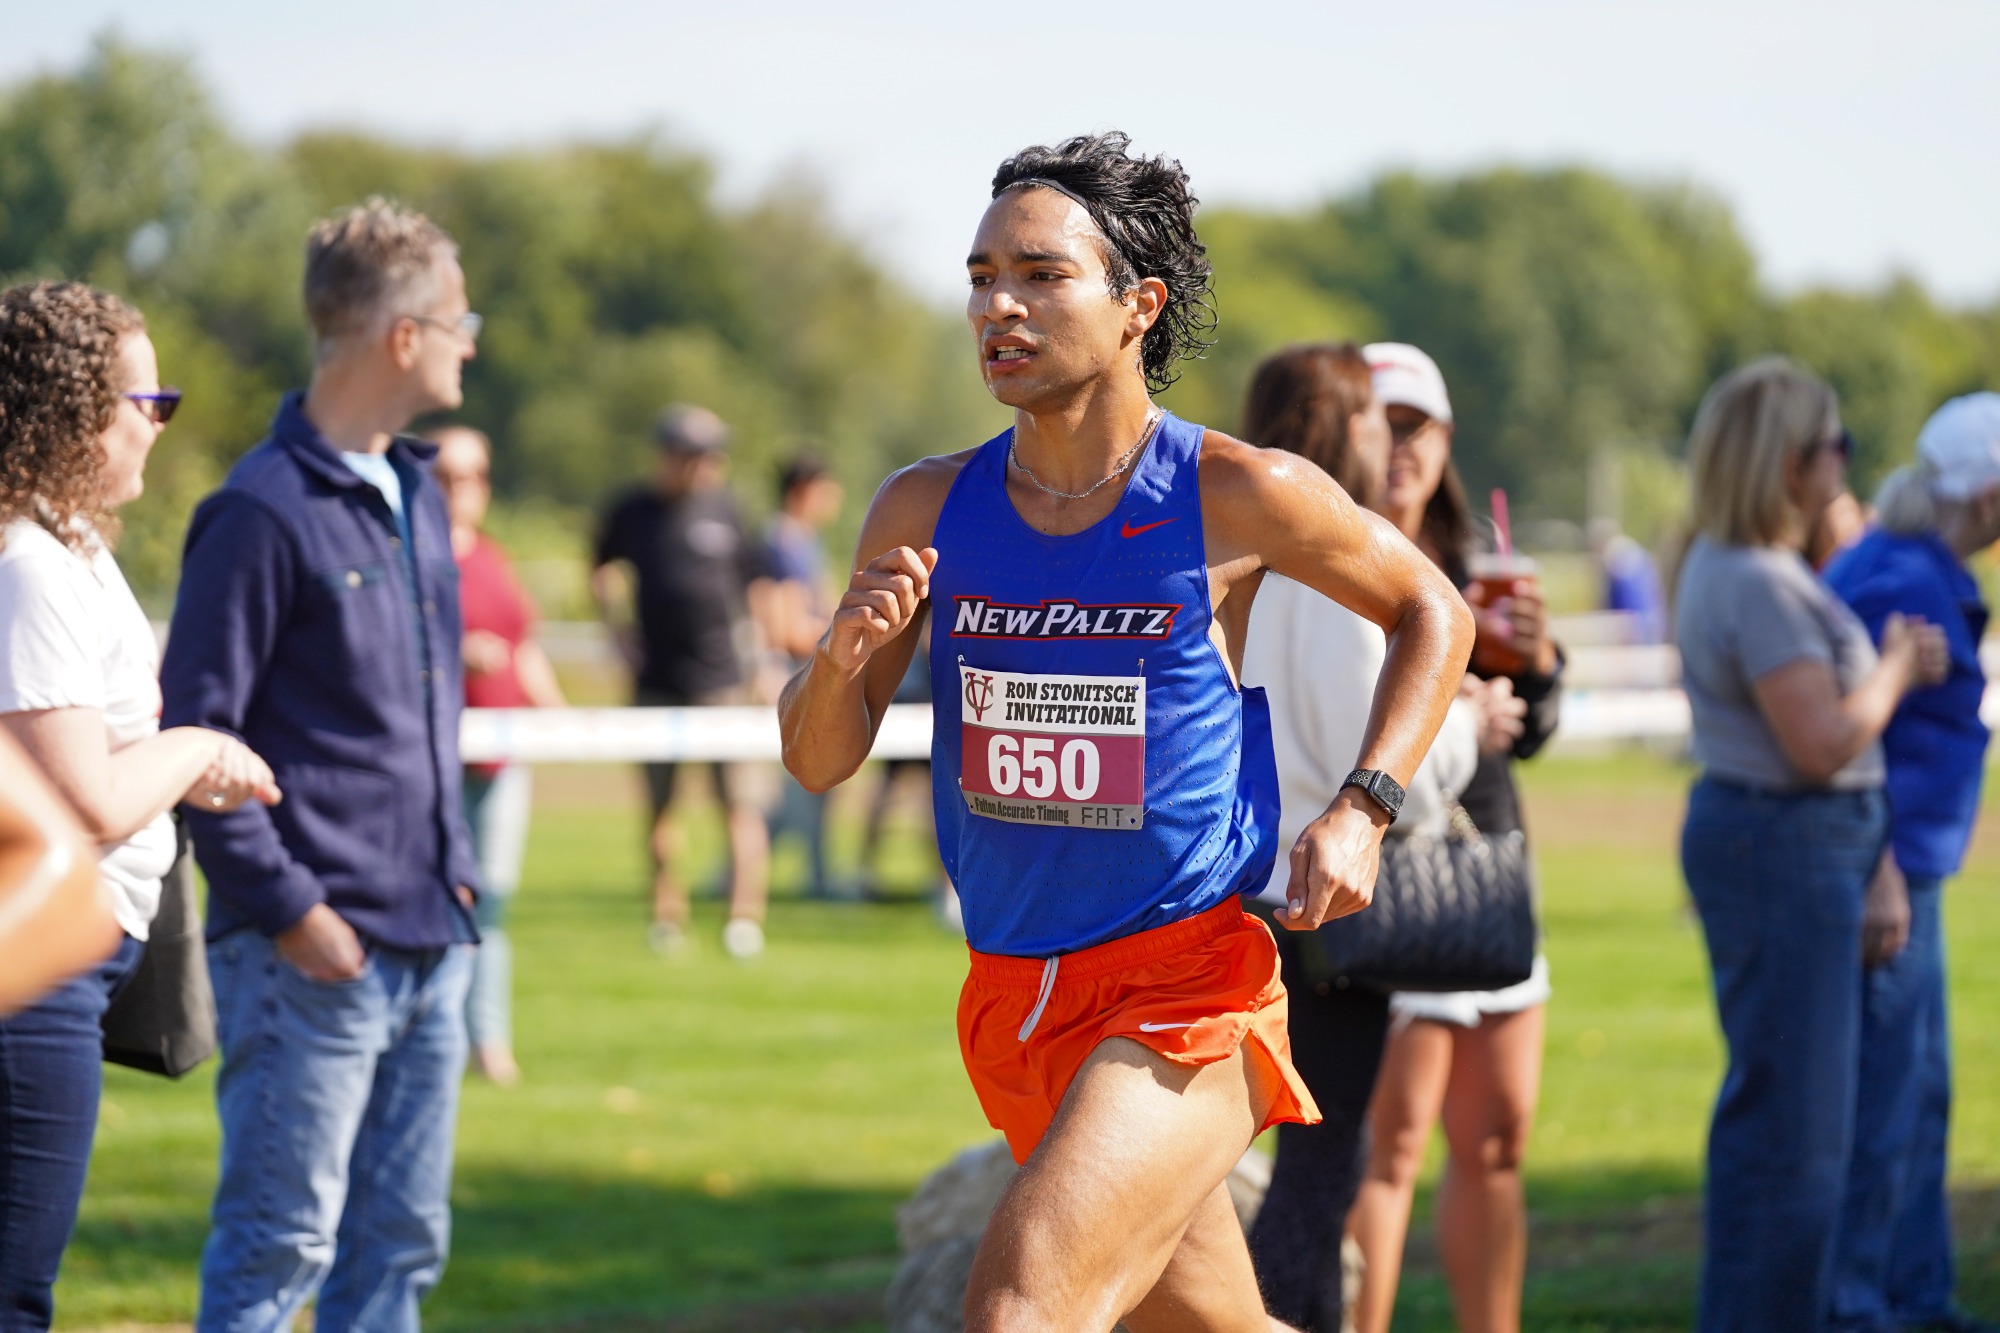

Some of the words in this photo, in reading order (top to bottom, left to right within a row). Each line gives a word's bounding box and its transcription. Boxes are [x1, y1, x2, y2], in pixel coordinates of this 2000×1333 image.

[955, 601, 1040, 635] NEW
[1039, 604, 1170, 635] PALTZ
[1005, 681, 1038, 701] RON
[1040, 682, 1137, 703] STONITSCH
[1005, 701, 1136, 725] INVITATIONAL
[987, 734, 1100, 800] 650
[974, 796, 997, 814] Fulton
[997, 801, 1036, 820] Accurate
[1036, 804, 1070, 825] Timing
[1081, 807, 1125, 827] FAT
